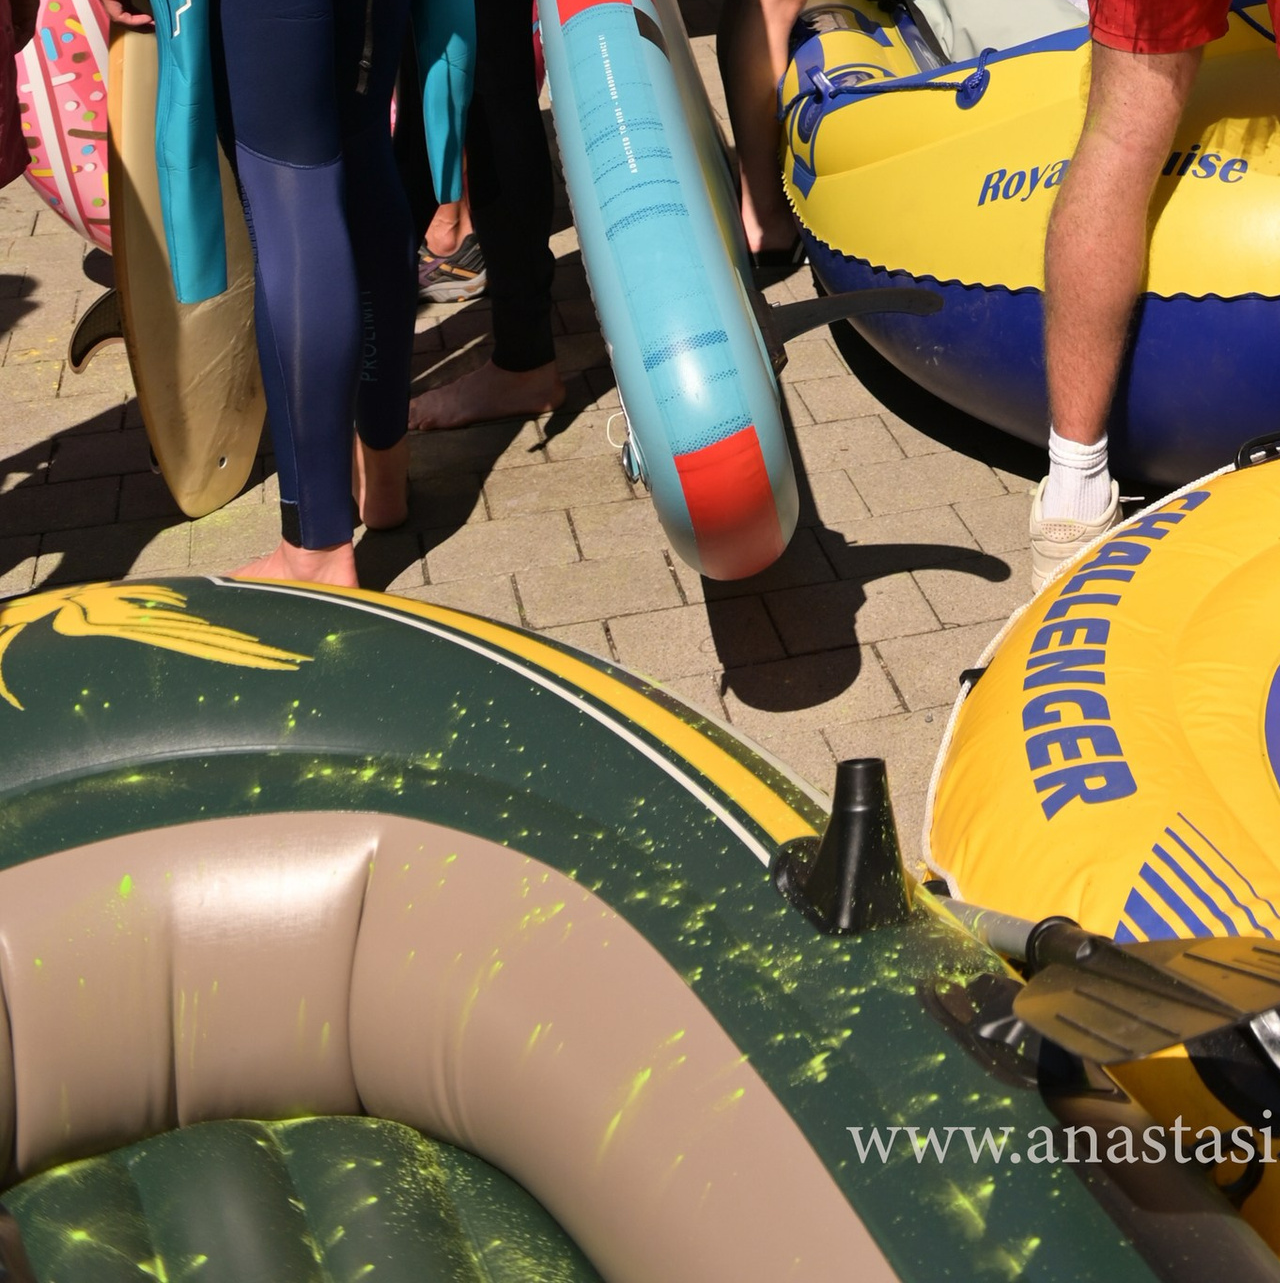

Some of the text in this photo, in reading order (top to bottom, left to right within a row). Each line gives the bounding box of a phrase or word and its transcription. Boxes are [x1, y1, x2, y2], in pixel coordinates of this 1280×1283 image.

[614, 107, 624, 123] RIDE
[619, 124, 627, 135] TO
[622, 136, 638, 174] ADDICTED
[977, 158, 1071, 207] Roya
[1022, 491, 1212, 822] CHALLENGER
